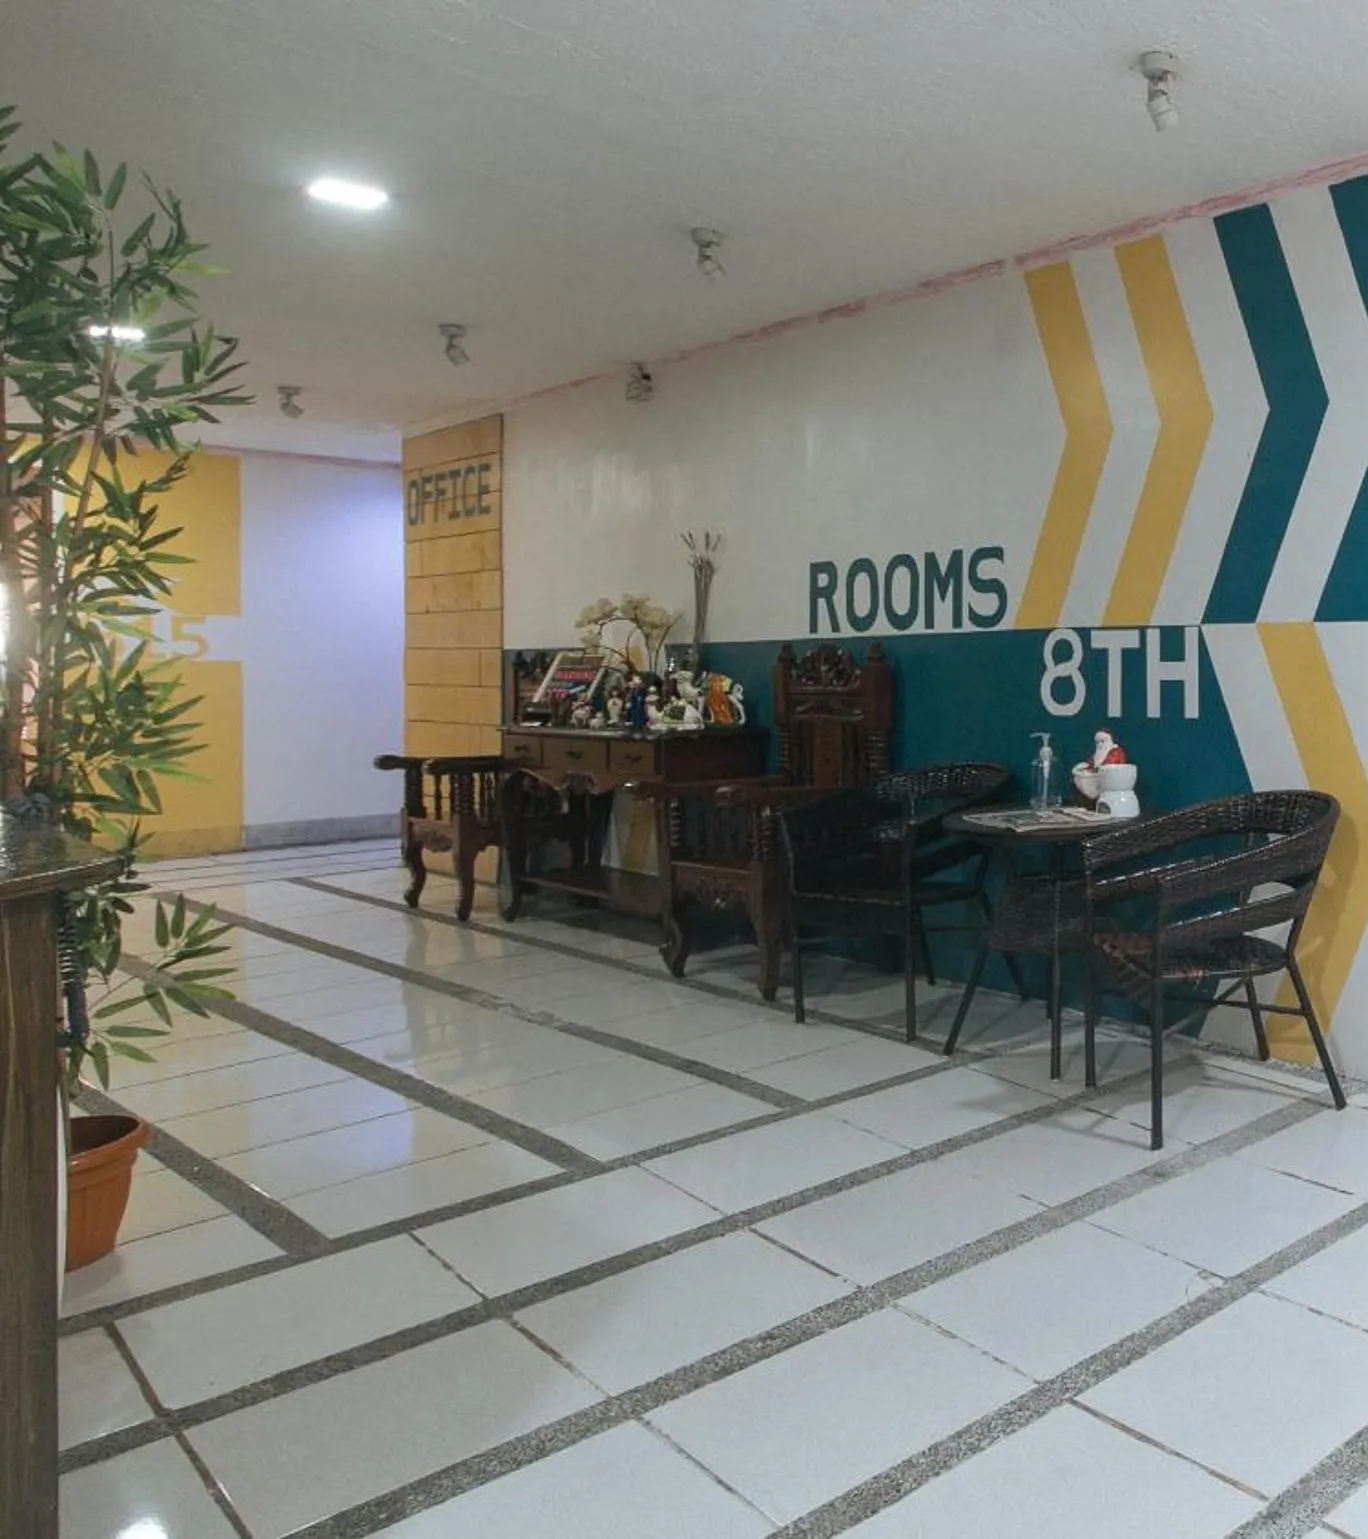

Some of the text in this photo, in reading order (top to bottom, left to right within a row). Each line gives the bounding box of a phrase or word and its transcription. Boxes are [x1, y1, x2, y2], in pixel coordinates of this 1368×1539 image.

[408, 463, 491, 526] OFFICE
[809, 546, 1008, 634] ROOMS
[1040, 626, 1199, 719] 8TH
